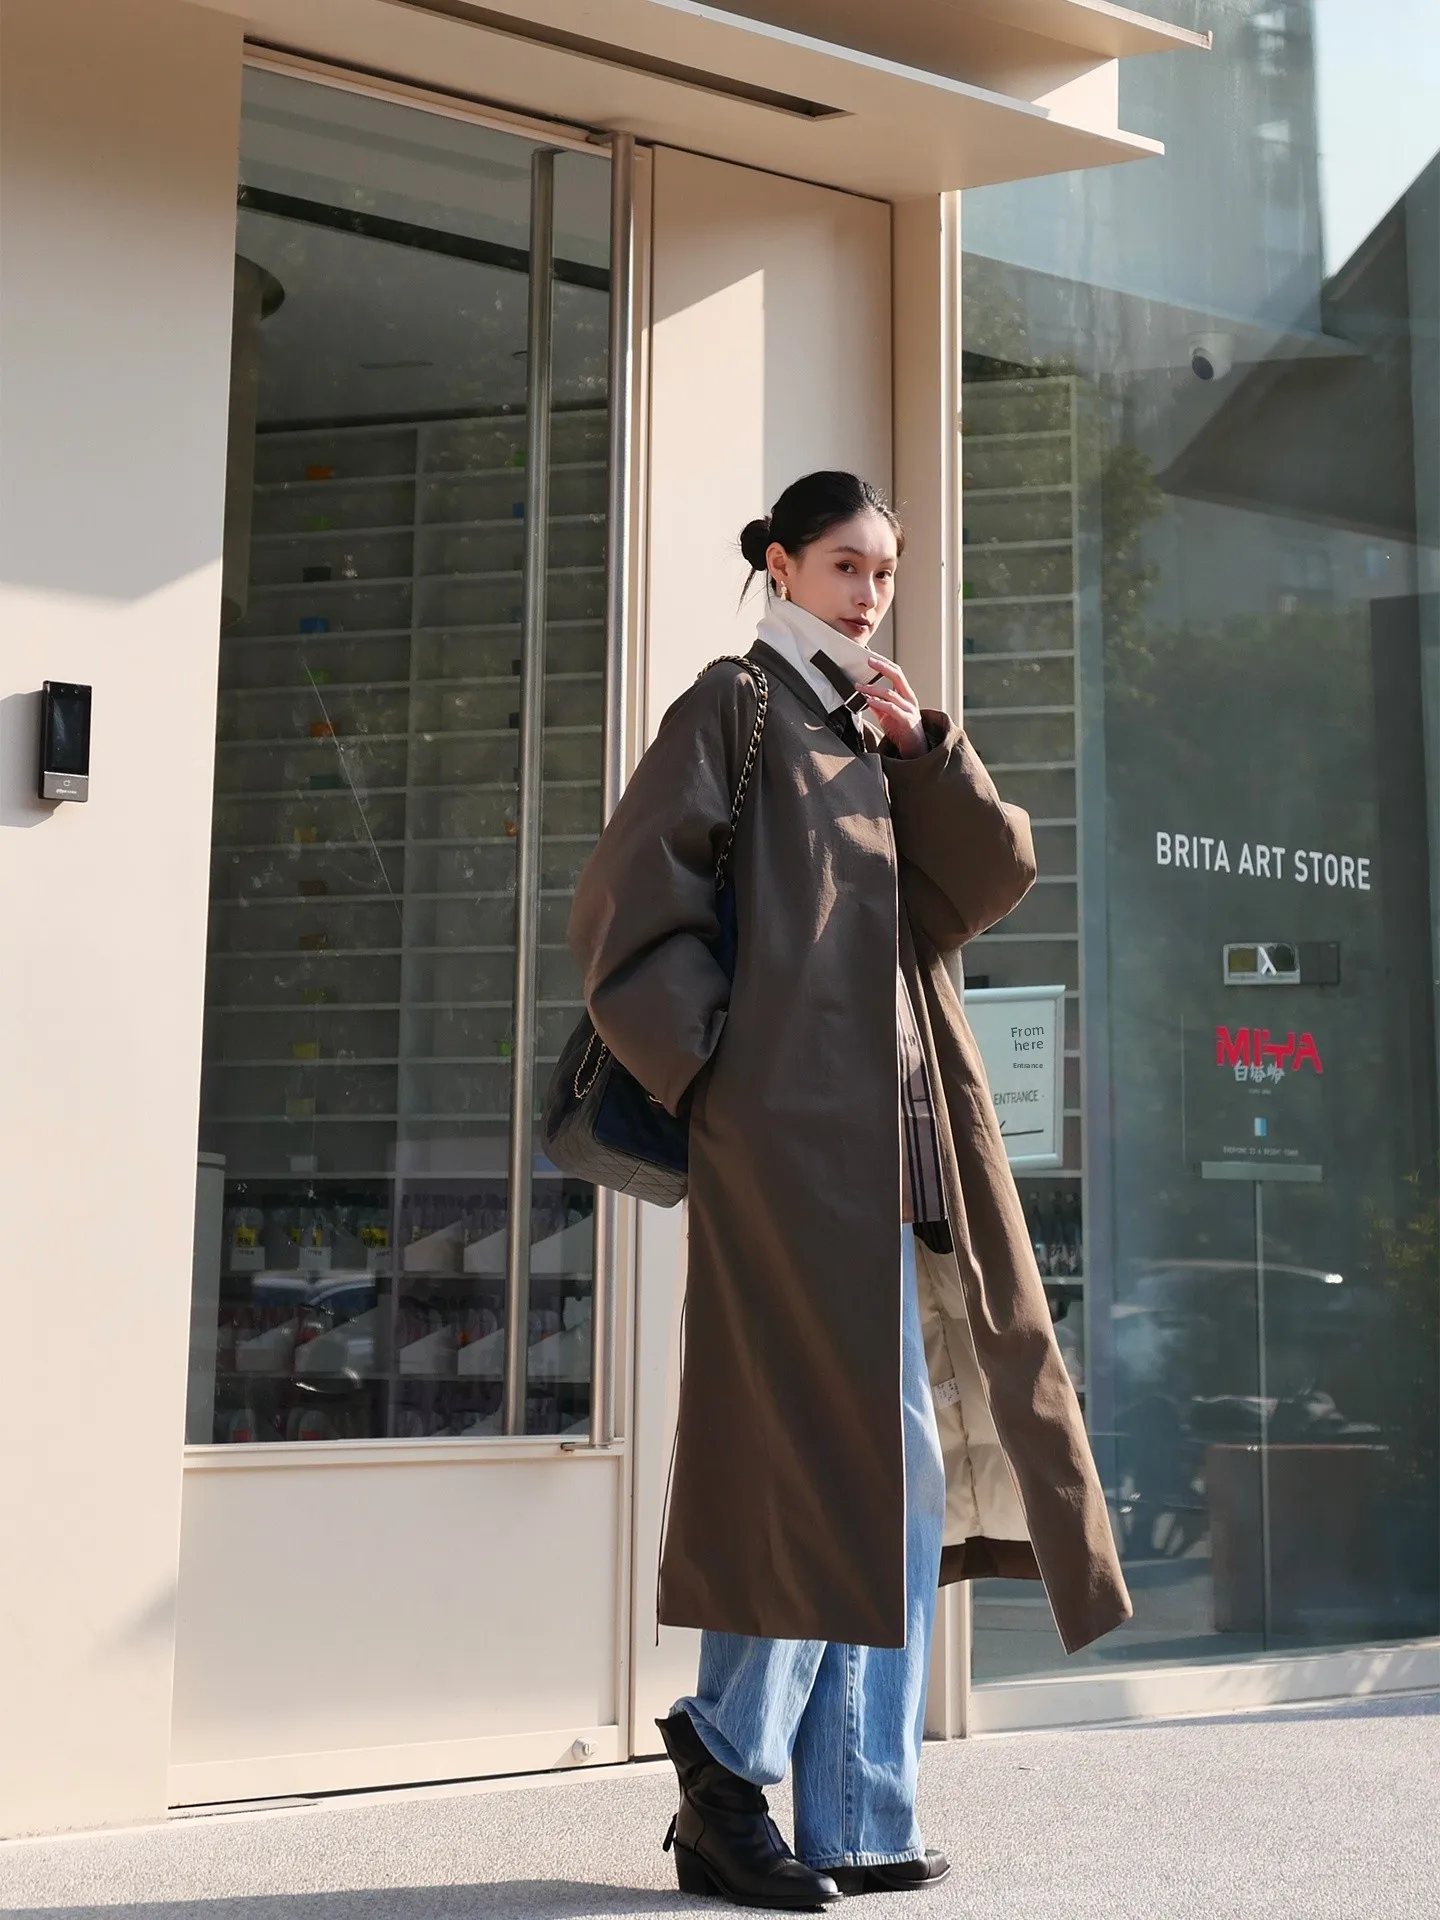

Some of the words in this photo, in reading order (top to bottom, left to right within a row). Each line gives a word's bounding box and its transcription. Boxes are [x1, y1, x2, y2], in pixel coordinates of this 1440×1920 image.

[1156, 831, 1231, 873] BRITA
[1238, 842, 1286, 880] ART
[1294, 849, 1371, 890] STORE
[1010, 1026, 1045, 1038] From
[1014, 1040, 1044, 1052] here
[993, 1089, 1040, 1106] ENTRANCE
